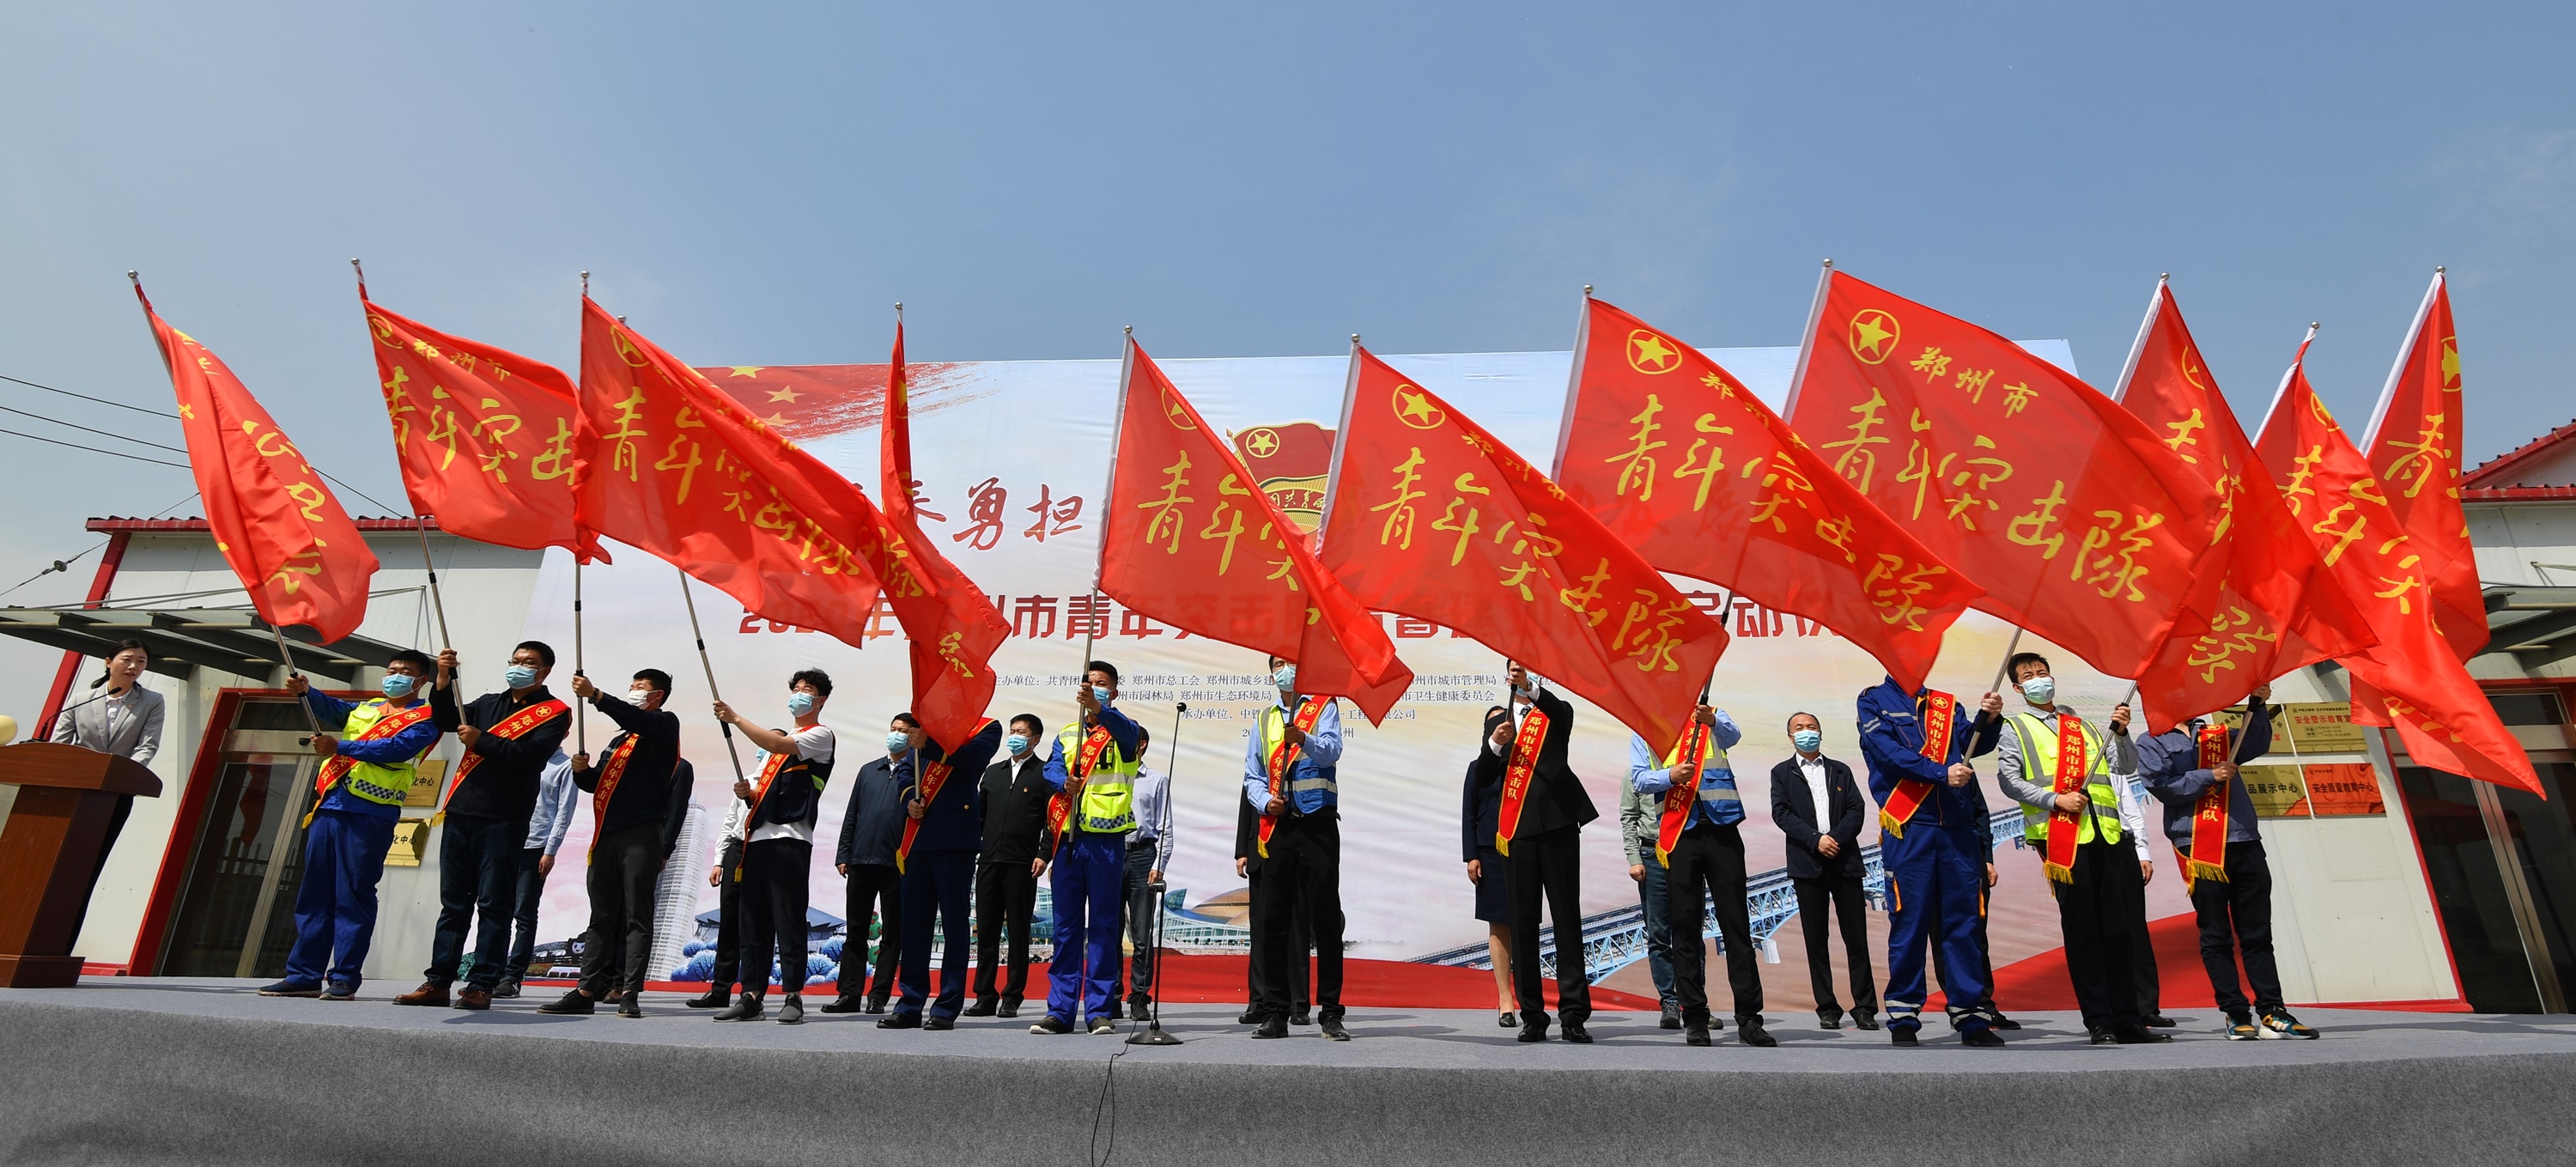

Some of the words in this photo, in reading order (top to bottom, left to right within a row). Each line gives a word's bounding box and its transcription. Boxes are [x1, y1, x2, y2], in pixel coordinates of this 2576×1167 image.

[1910, 346, 2039, 419] 郑州市
[1133, 675, 1200, 686] 郑州市总工会
[1180, 690, 1273, 702] 郑州市生态环境局
[1507, 716, 1542, 800] 郑州市青年突击队
[596, 733, 639, 811] 州市青年突击队
[2244, 782, 2299, 794] 品展示中心
[2312, 782, 2374, 794] 安全质量教育中心
